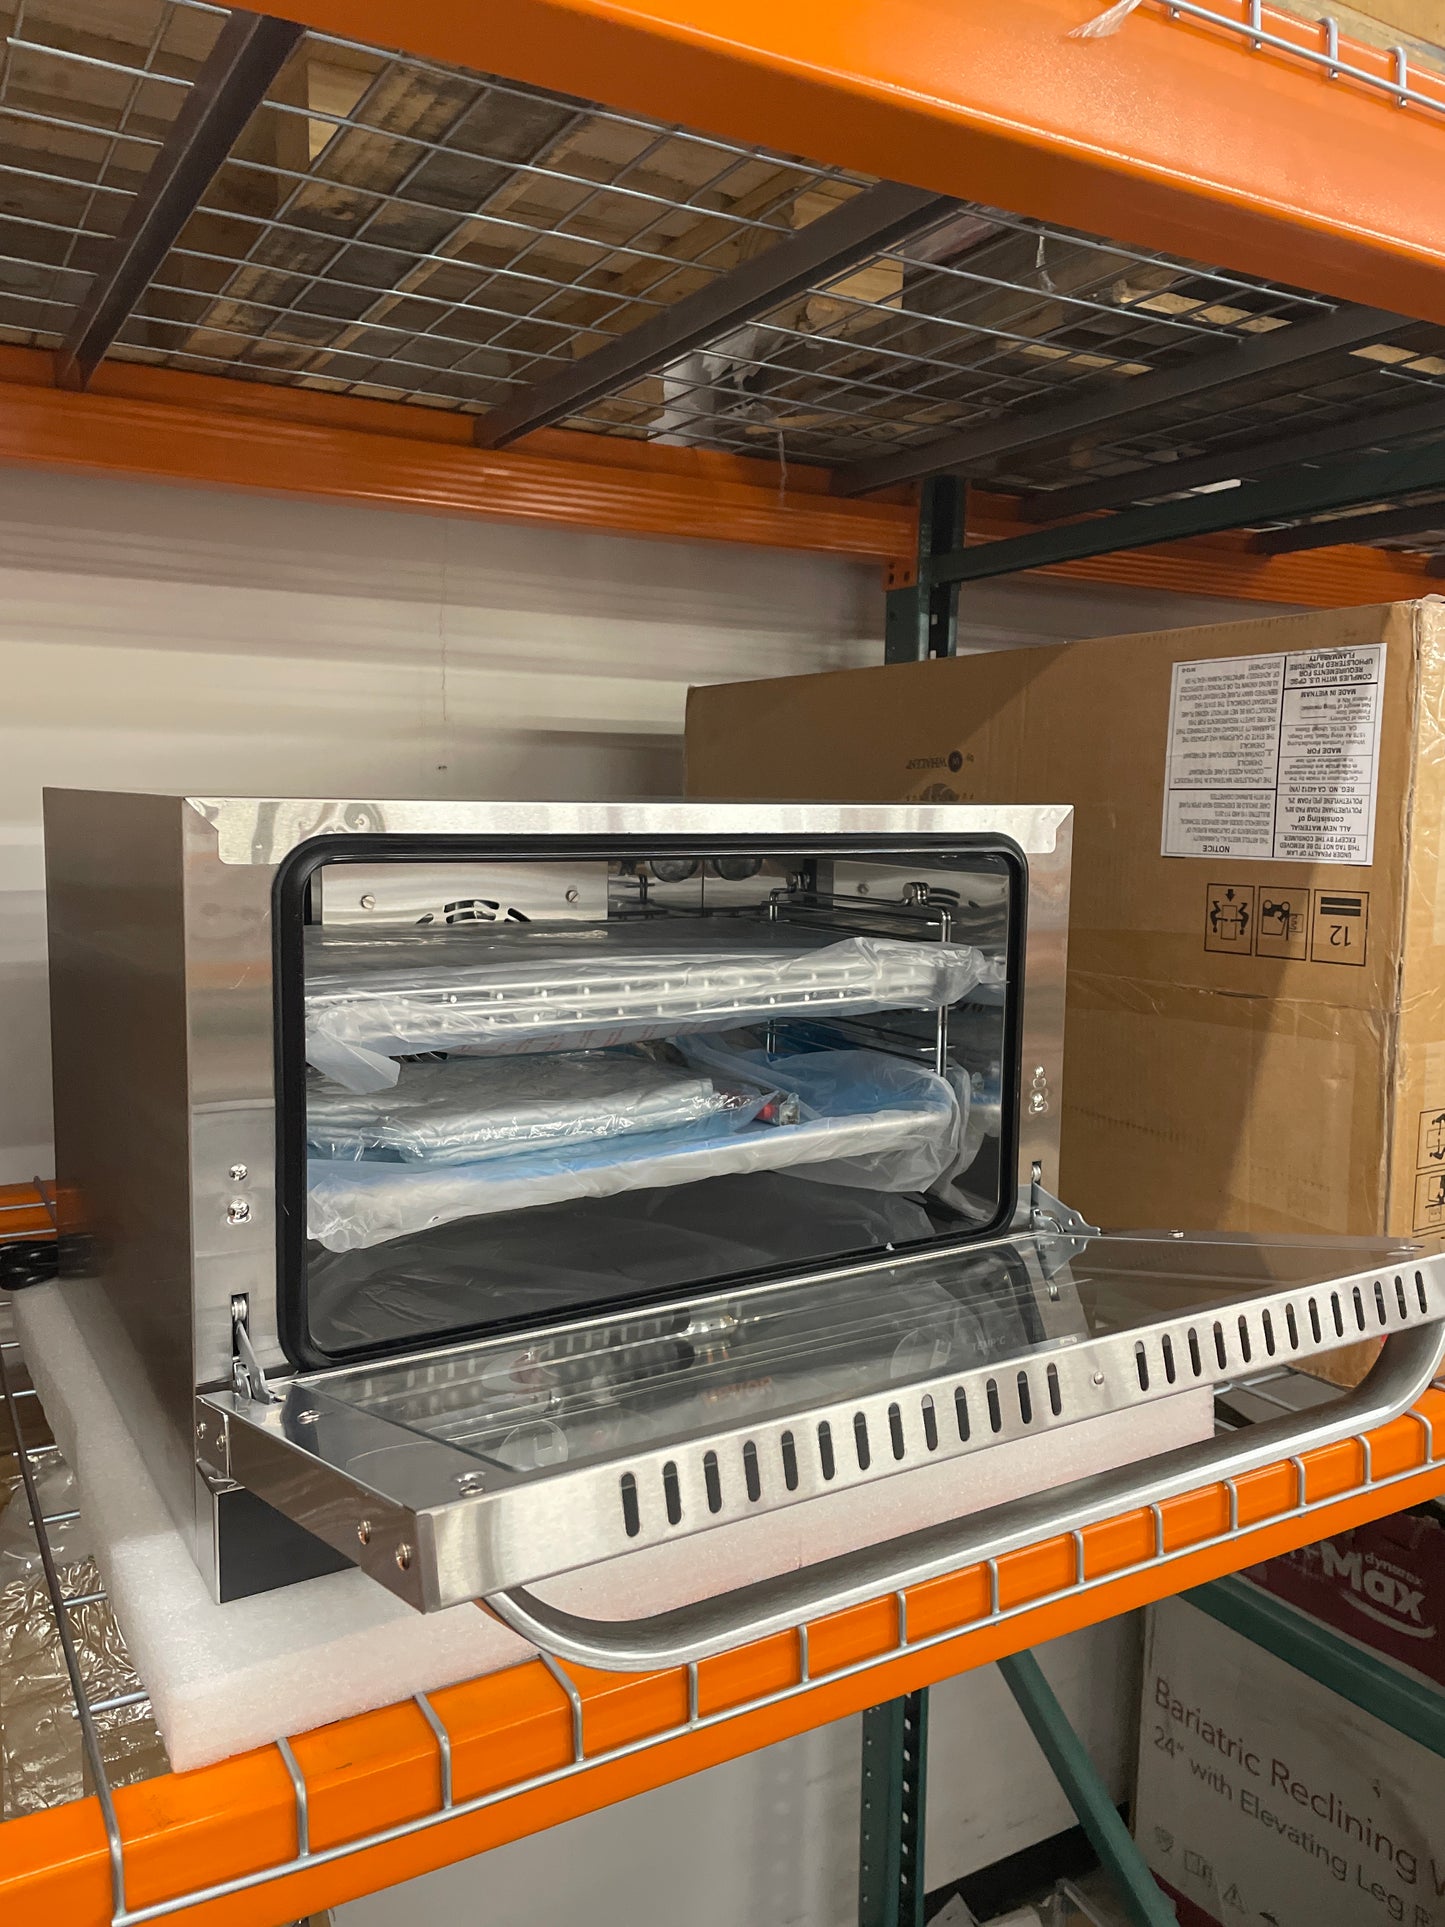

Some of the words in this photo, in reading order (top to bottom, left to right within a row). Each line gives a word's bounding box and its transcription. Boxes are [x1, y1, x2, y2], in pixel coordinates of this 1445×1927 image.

[1325, 658, 1373, 667] UPHOLSTERED
[1313, 667, 1363, 675] REQUIREMENTS
[1339, 674, 1372, 682] COMPLIES
[1307, 815, 1344, 823] consisting
[1203, 845, 1230, 853] NOTICE
[1330, 925, 1351, 947] 12
[1320, 1540, 1426, 1625] Max
[1155, 1676, 1261, 1777] Bariatric
[1271, 1758, 1418, 1885] Reclining
[1188, 1758, 1233, 1800] with
[1240, 1789, 1348, 1882] Elevating
[1357, 1864, 1404, 1922] Leg
